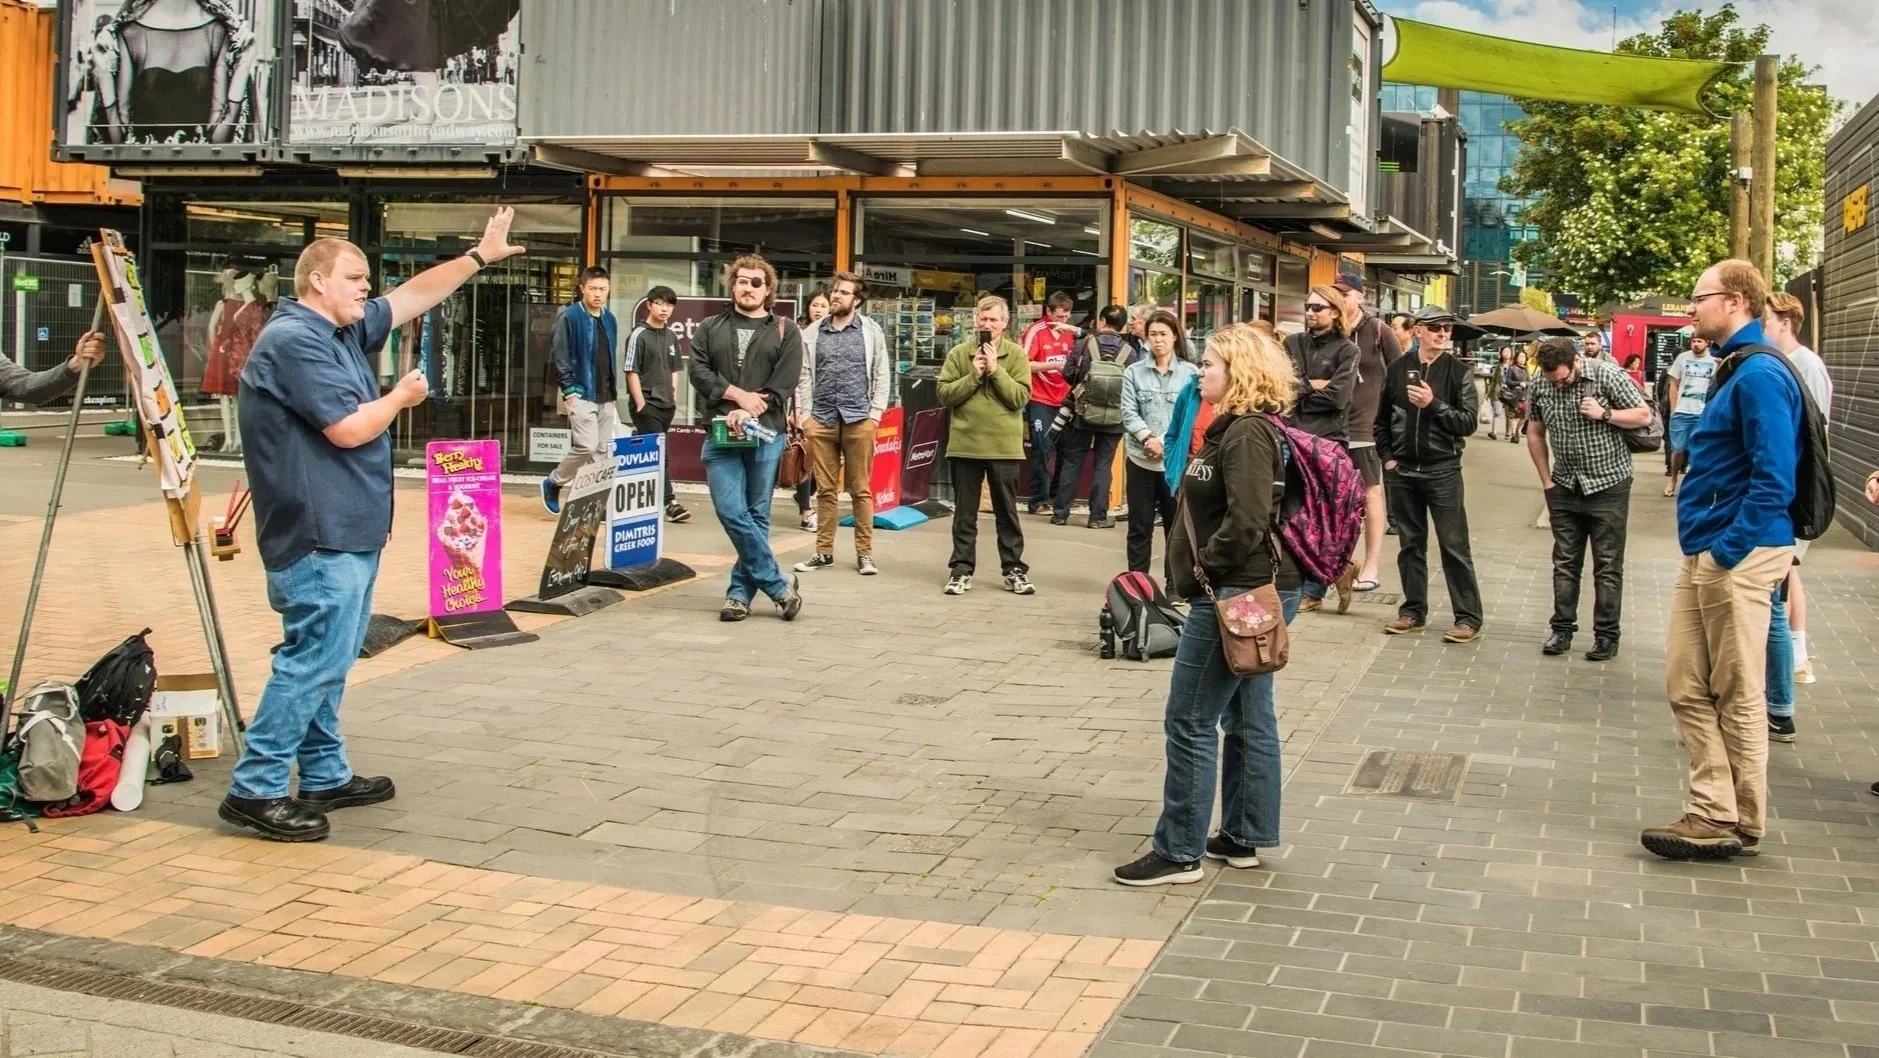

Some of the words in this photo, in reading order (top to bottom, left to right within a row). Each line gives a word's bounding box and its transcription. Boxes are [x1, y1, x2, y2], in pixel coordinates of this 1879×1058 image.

[292, 84, 517, 121] MADISONS
[0, 231, 10, 241] LD
[533, 431, 568, 439] CONTAINERS
[432, 449, 465, 465] Berry
[441, 456, 484, 475] Healthy
[616, 479, 656, 513] OPEN
[615, 525, 656, 543] DIMITRIS
[614, 540, 636, 552] GREEK
[637, 537, 656, 547] FOOD
[443, 566, 474, 582] Your
[441, 577, 485, 598] Healthy
